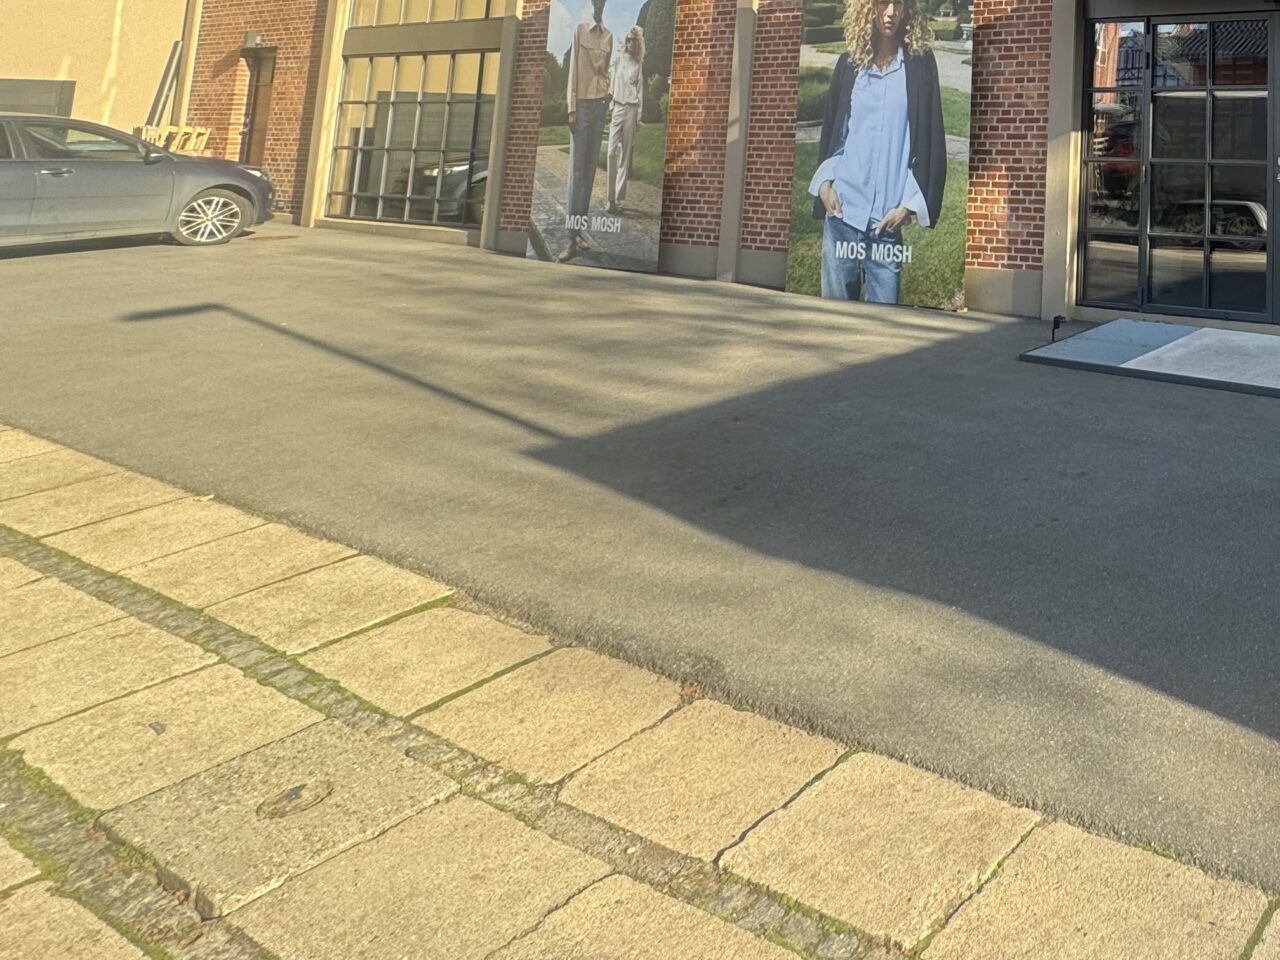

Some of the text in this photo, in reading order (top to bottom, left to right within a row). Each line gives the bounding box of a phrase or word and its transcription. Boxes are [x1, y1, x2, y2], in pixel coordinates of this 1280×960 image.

[564, 214, 622, 233] MOS MOSH
[835, 241, 913, 263] MOS MOSH
